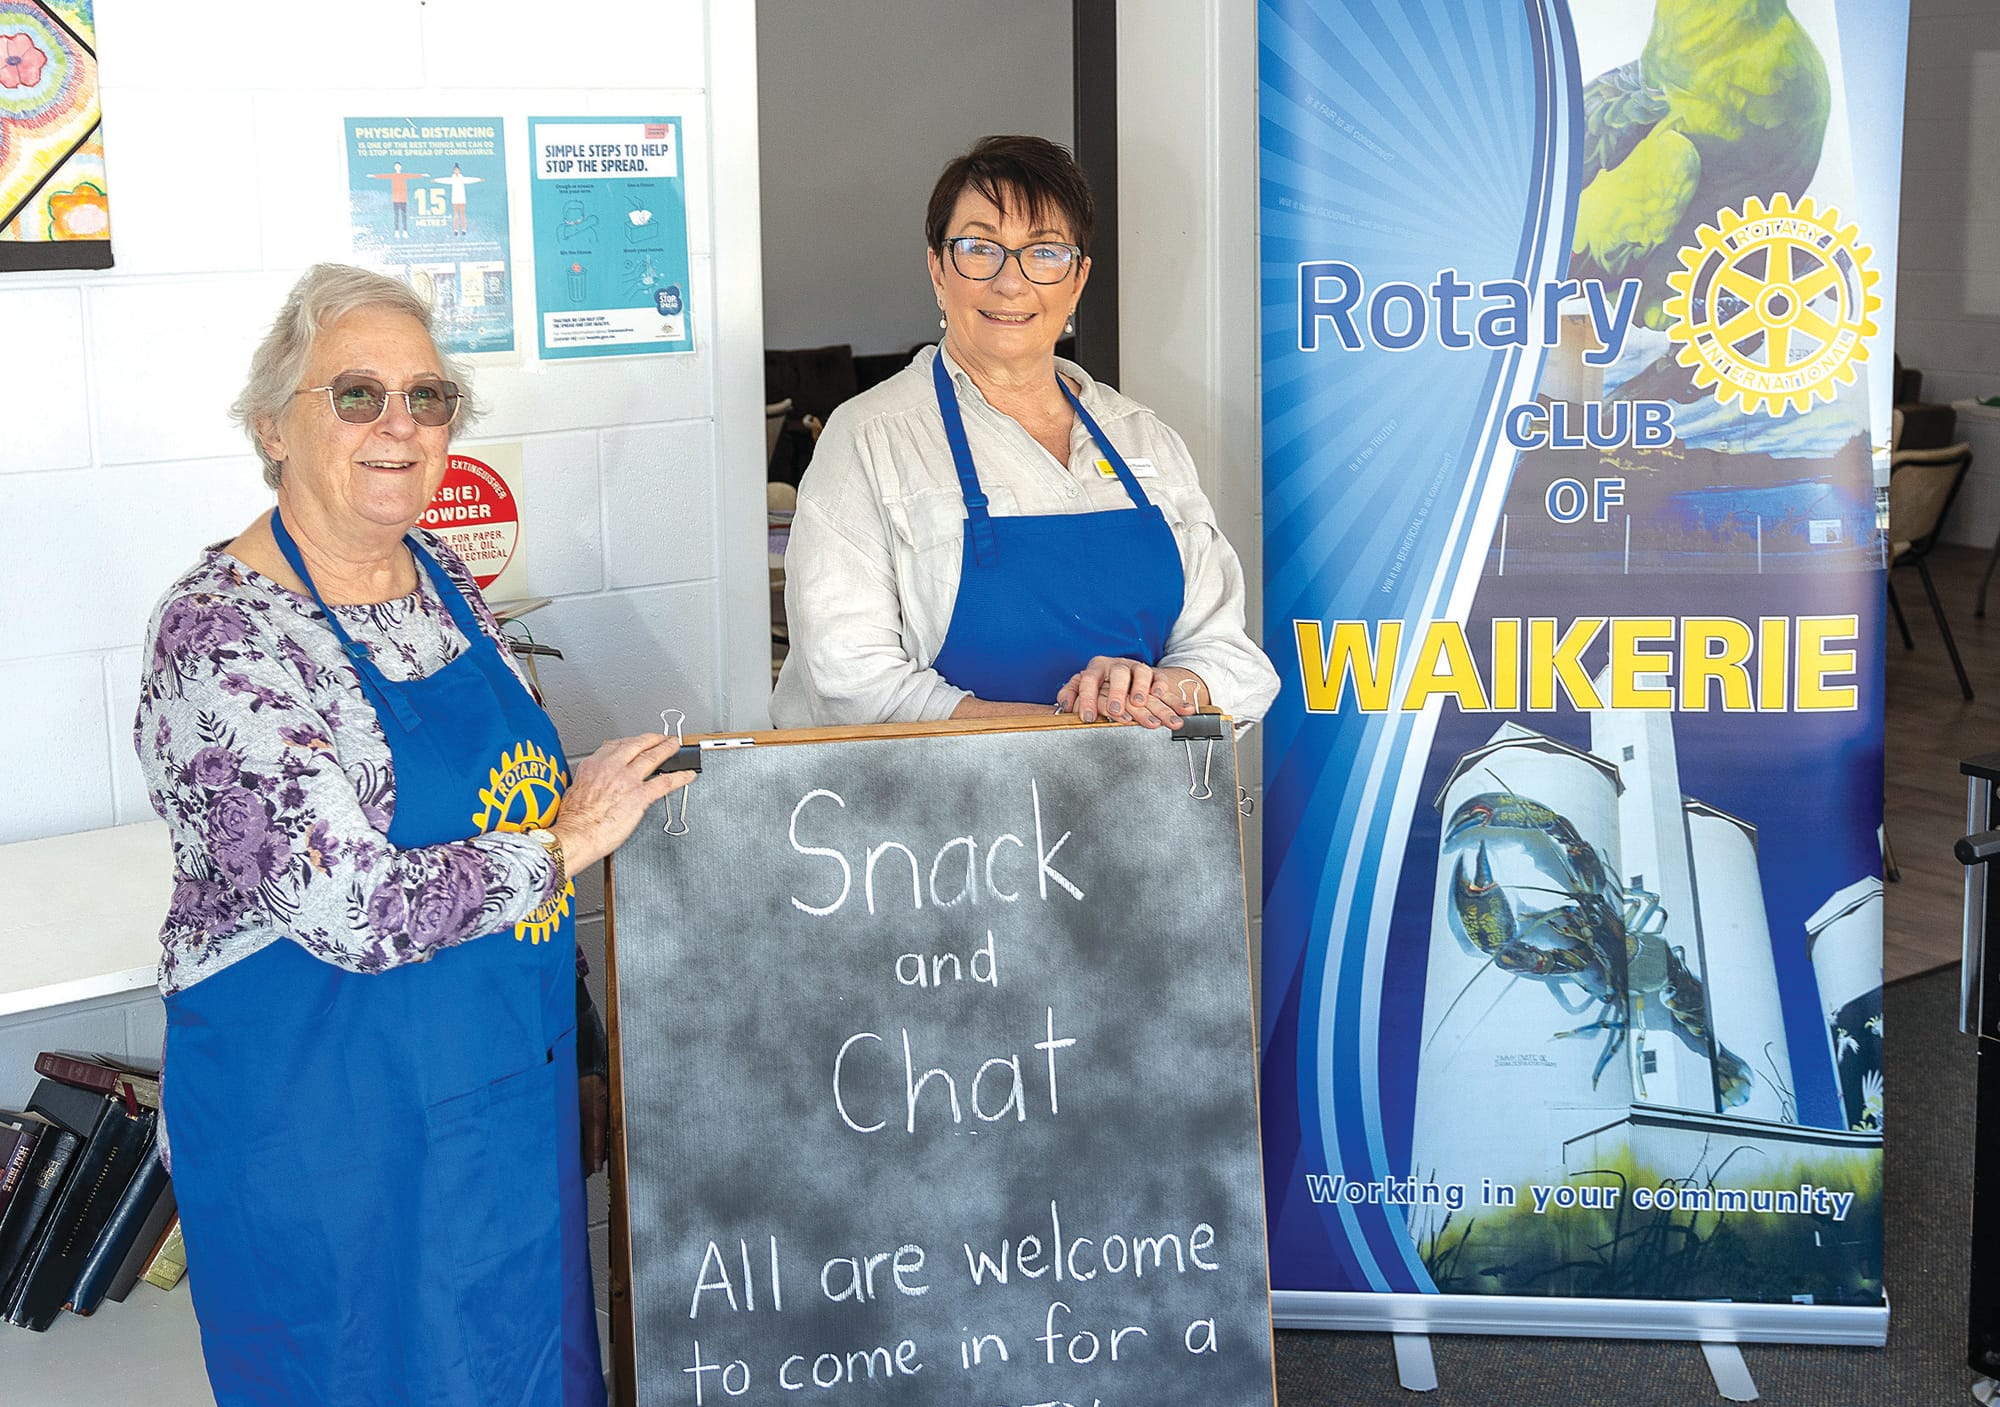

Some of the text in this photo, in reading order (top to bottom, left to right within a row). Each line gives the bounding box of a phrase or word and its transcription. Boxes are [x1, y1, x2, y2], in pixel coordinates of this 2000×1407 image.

[355, 127, 495, 139] PHYSICAL DISTANCING
[545, 144, 669, 158] SIMPLE STEPS TO HELP
[546, 159, 648, 173] STOP THE SPREAD.
[414, 188, 446, 215] 1.5
[1734, 221, 1825, 247] ROTARY
[1298, 259, 1642, 367] Rotary
[1702, 333, 1851, 390] INTERNATIONAL
[1504, 400, 1676, 450] CLUB
[451, 459, 508, 500] EXTINGUISHER
[1545, 477, 1625, 524] OF
[452, 533, 470, 543] FOR
[1397, 517, 1425, 561] BENEFICIAL
[1293, 615, 1859, 714] WAIKERIE
[498, 762, 547, 797] ROTARY
[788, 777, 1085, 916] Snack
[895, 930, 998, 989] and
[832, 1005, 1077, 1135] Chat
[1306, 1175, 1854, 1221] Working in your community
[689, 1200, 1220, 1319] All are welcome
[683, 1302, 1218, 1406] to come in for a
